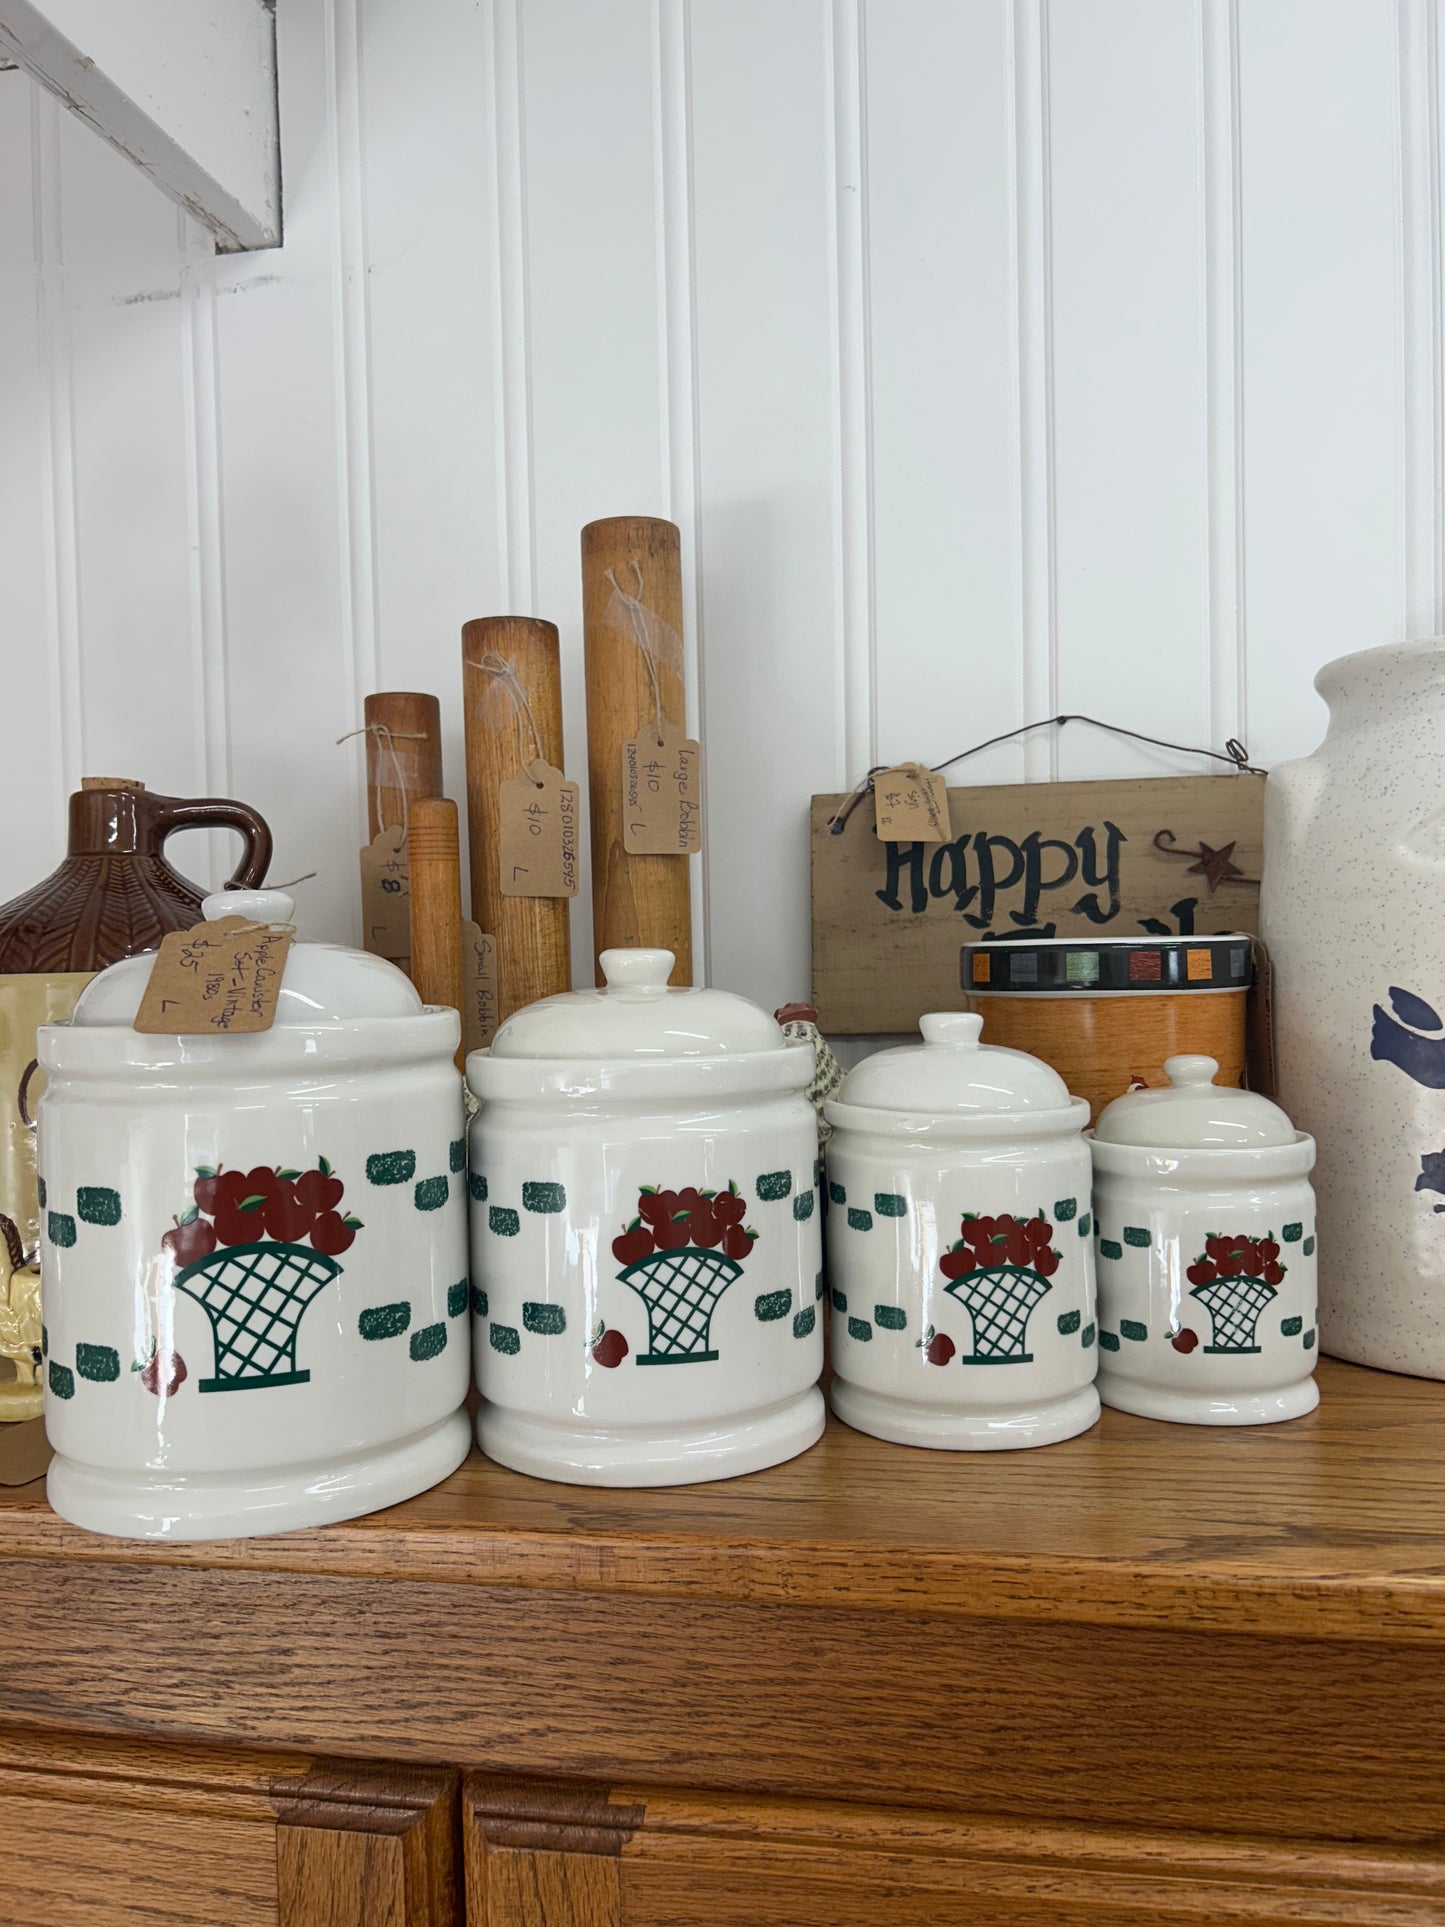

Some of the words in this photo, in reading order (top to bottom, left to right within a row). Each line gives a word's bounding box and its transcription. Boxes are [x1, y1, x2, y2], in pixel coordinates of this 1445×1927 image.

[642, 760, 667, 793] $10
[522, 802, 548, 836] $10
[630, 823, 646, 836] L
[678, 800, 700, 847] Bobbin
[513, 866, 529, 882] L
[875, 821, 1128, 929] Happy
[253, 935, 283, 966] Apple
[371, 926, 388, 942] L
[179, 938, 223, 973] $25
[474, 940, 493, 980] Small
[202, 973, 225, 1001] 1980s
[162, 1000, 180, 1013] L
[476, 990, 495, 1037] Bobbin
